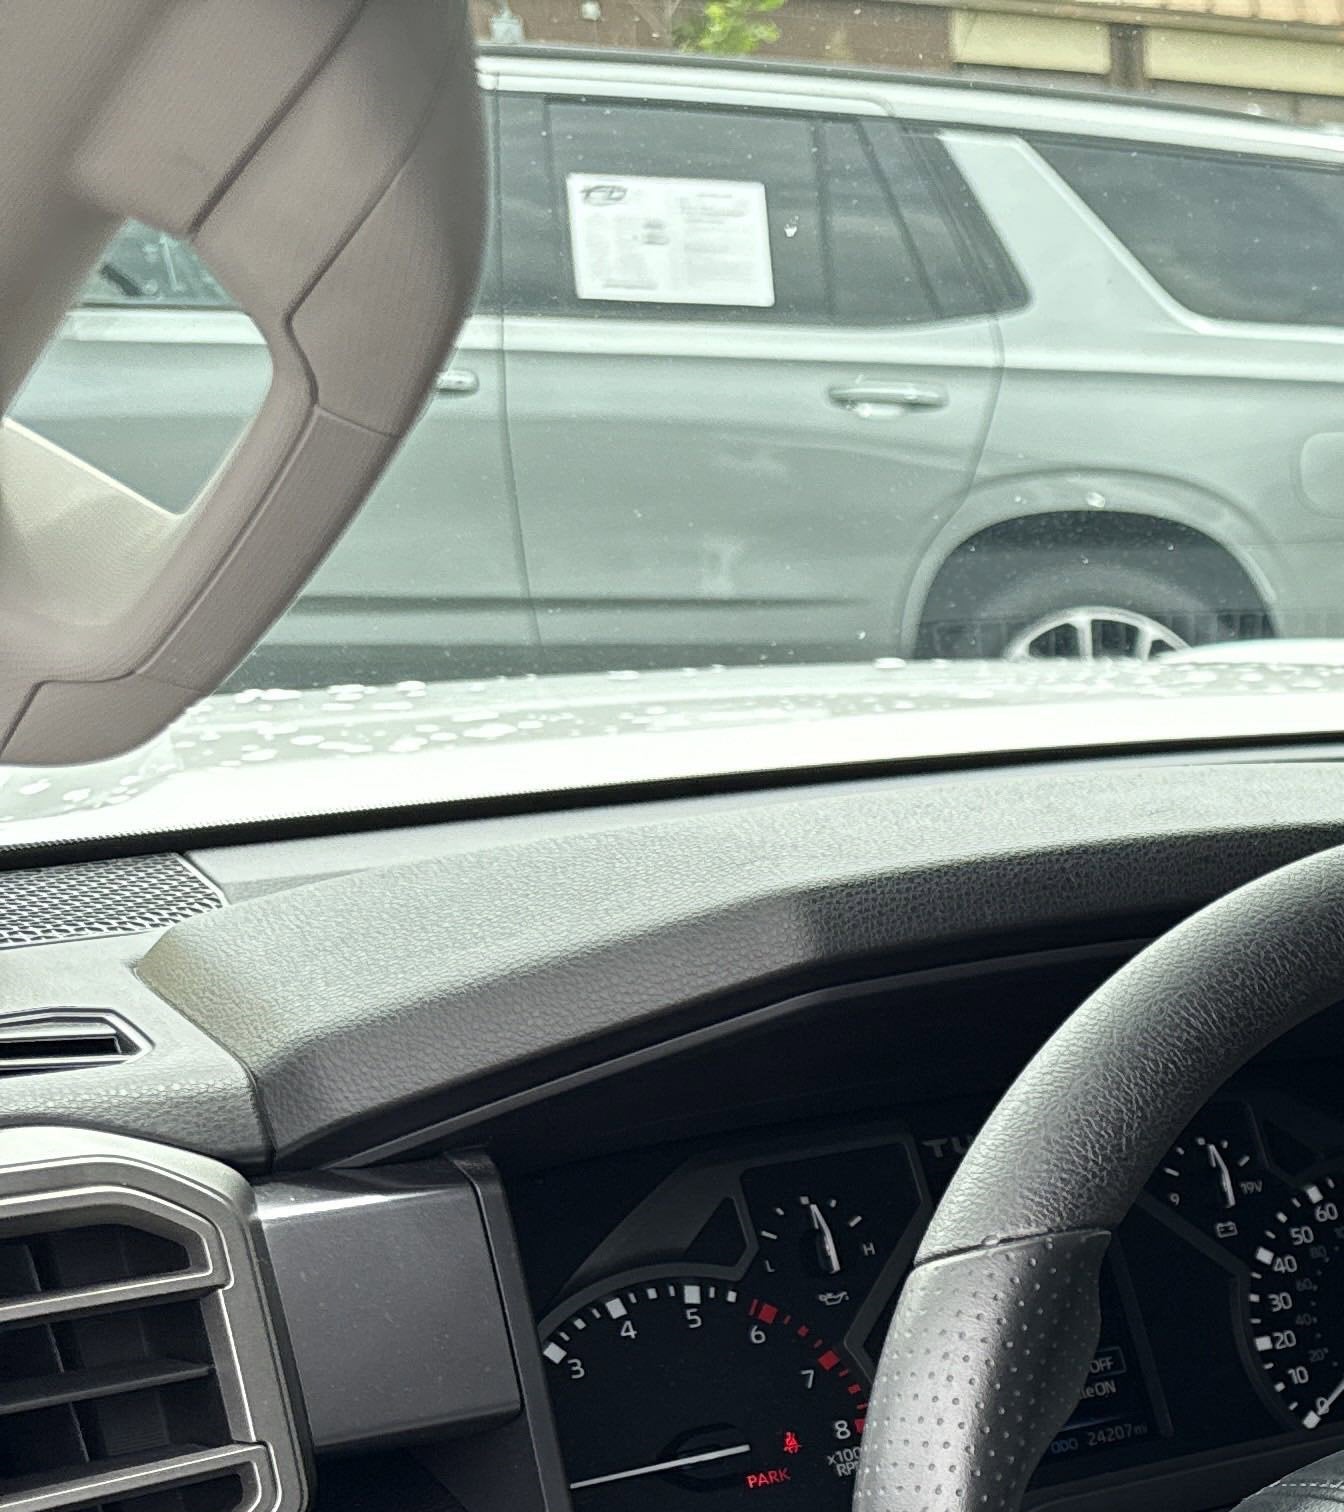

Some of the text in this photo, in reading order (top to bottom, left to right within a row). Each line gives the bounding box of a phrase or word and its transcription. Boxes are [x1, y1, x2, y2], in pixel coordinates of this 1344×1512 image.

[1170, 1193, 1180, 1205] 9
[1315, 1202, 1339, 1222] 60
[1290, 1225, 1314, 1246] 50
[863, 1244, 876, 1256] H
[766, 1260, 776, 1273] L
[1272, 1255, 1298, 1274] 40
[1268, 1292, 1293, 1313] 30
[686, 1308, 702, 1329] 5
[620, 1320, 638, 1339] 4
[750, 1325, 767, 1345] 6
[1273, 1329, 1297, 1350] 20
[567, 1359, 586, 1380] 3
[1090, 1356, 1115, 1374] OFF
[801, 1369, 816, 1389] 7
[1288, 1366, 1310, 1385] 10
[834, 1420, 851, 1440] 8
[1051, 1438, 1079, 1454] ODO
[747, 1468, 791, 1488] PARK
